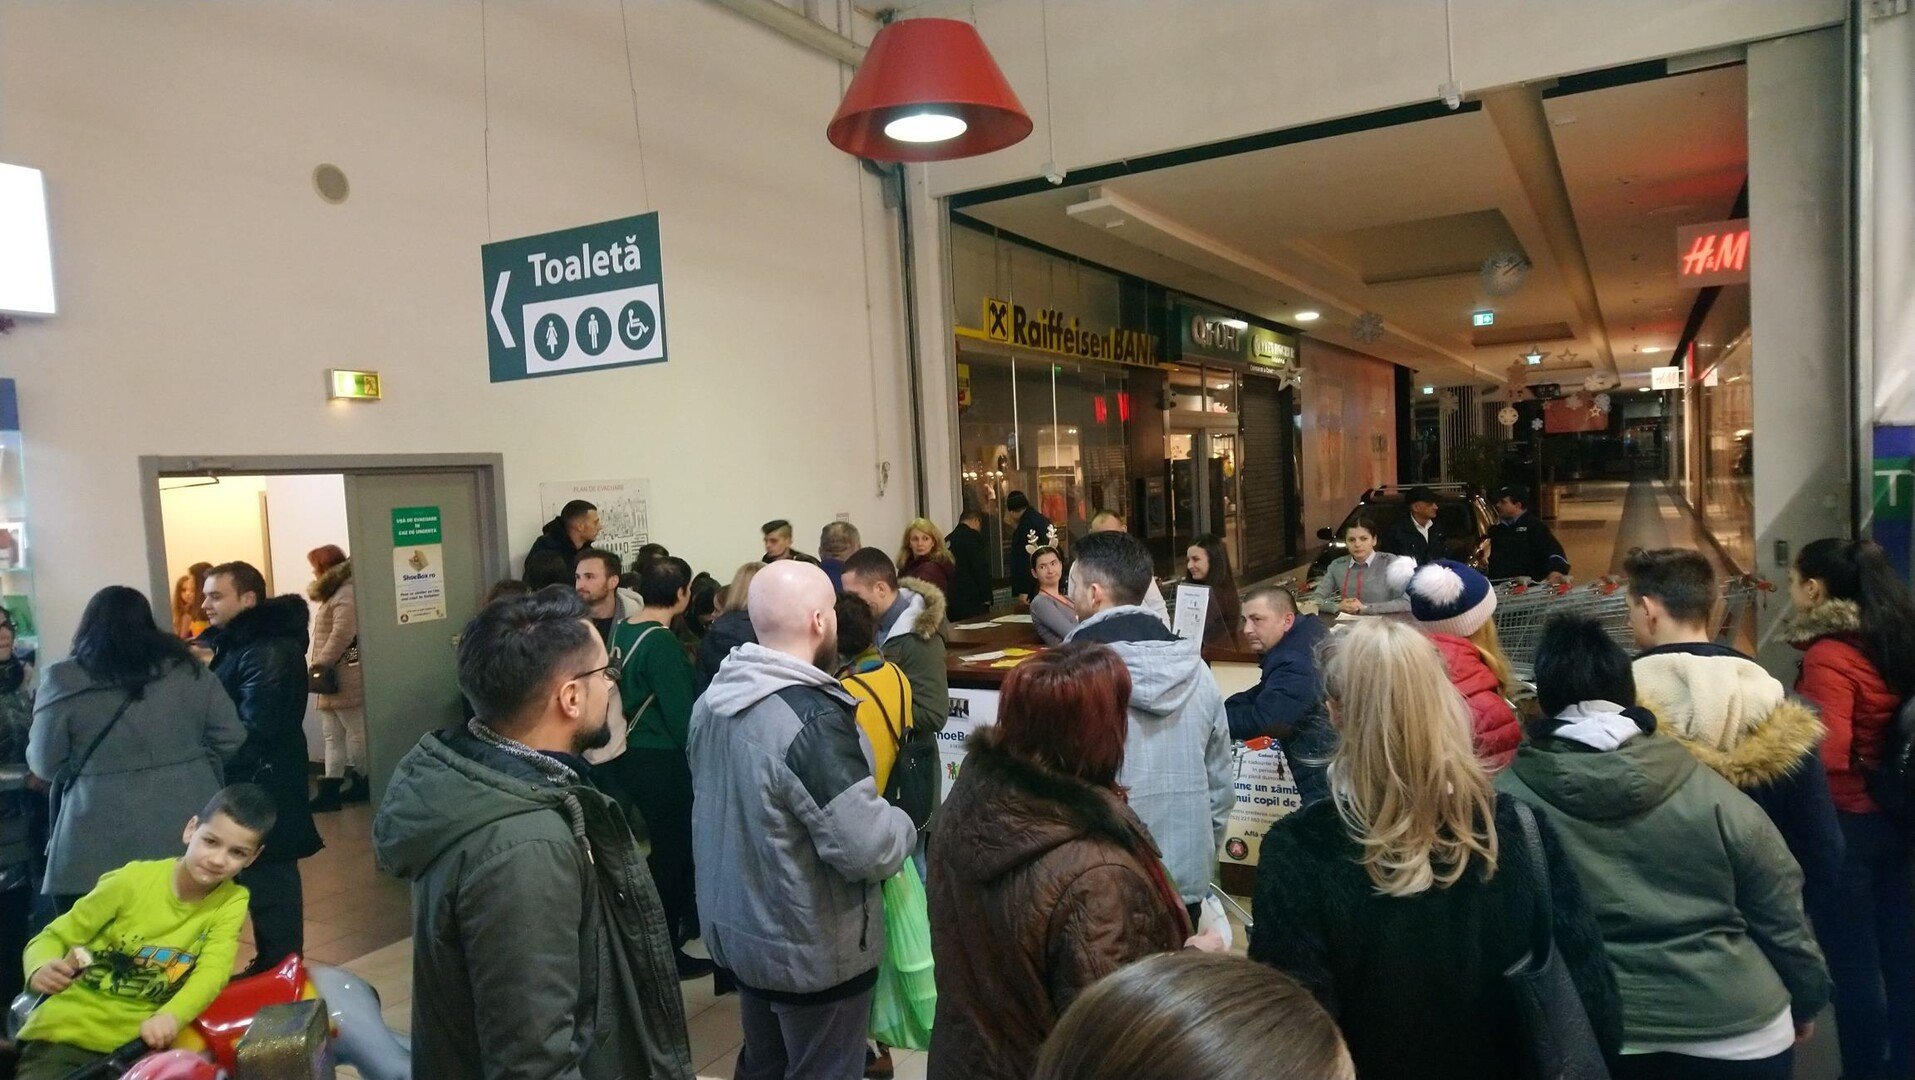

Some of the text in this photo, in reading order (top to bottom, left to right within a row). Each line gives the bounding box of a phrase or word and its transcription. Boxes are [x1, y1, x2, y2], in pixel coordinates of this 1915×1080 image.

[527, 234, 642, 287] Toaletă
[1680, 231, 1750, 276] H&M
[1013, 304, 1159, 367] Raiffeisen BANK
[936, 731, 969, 741] hoeB
[1234, 782, 1300, 795] une un zâmb
[1236, 794, 1297, 808] nui copil de
